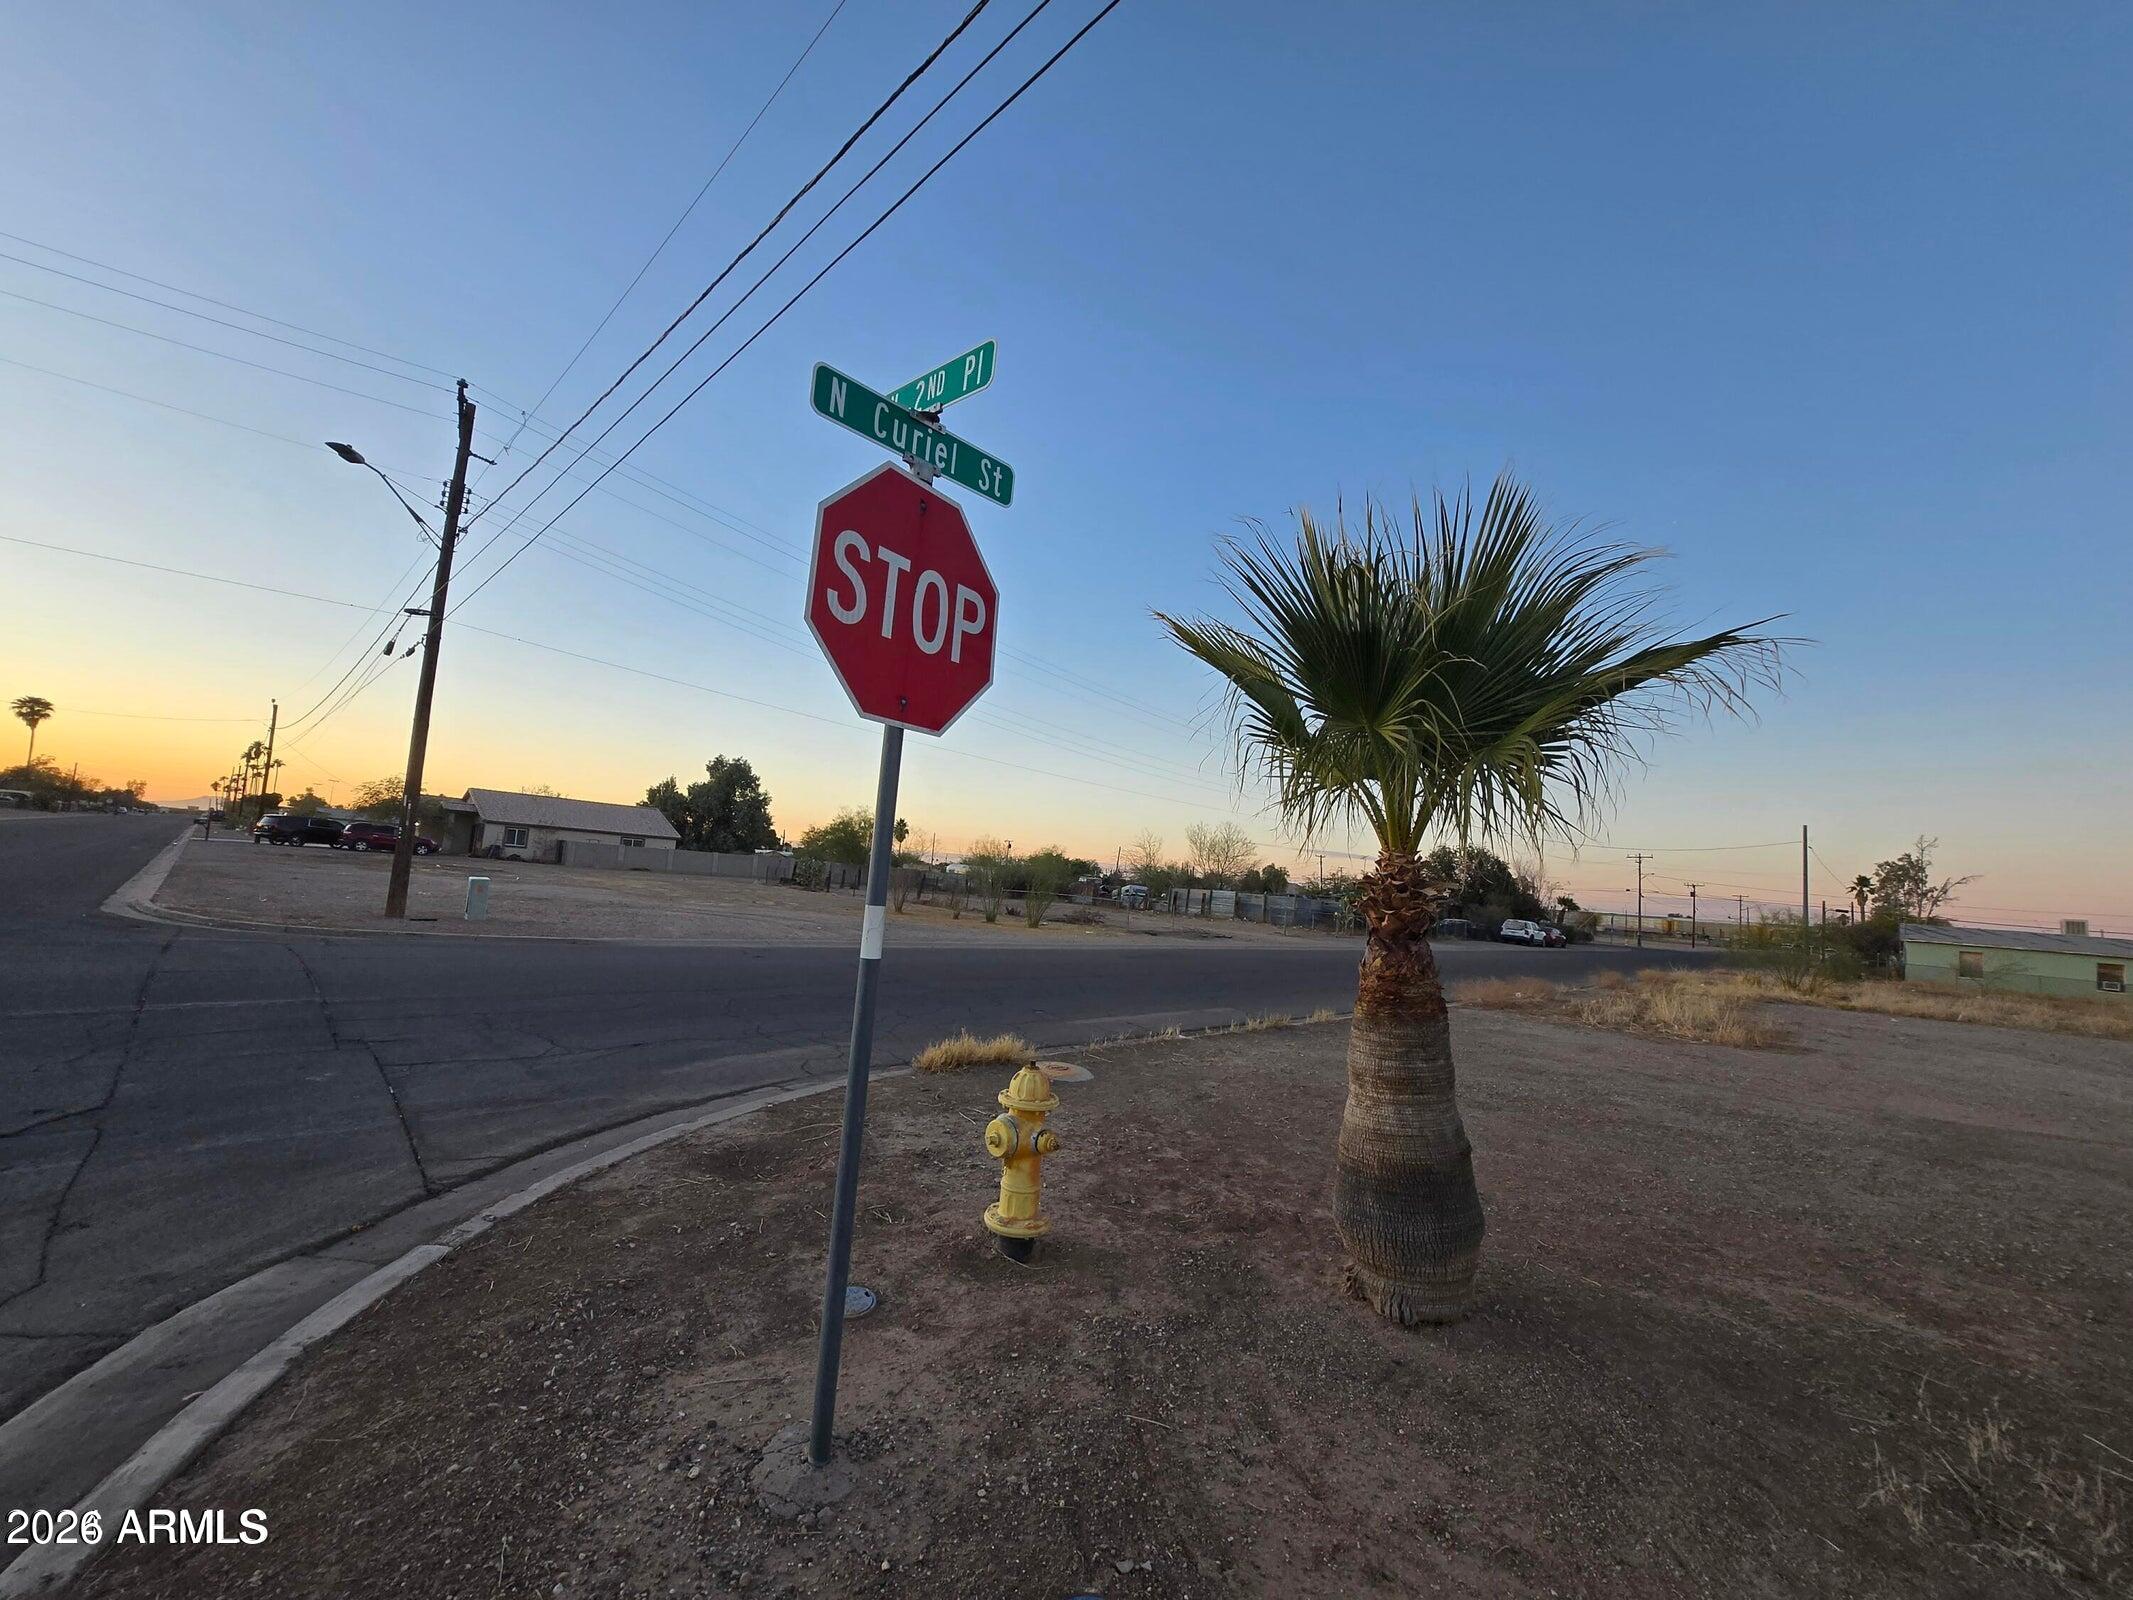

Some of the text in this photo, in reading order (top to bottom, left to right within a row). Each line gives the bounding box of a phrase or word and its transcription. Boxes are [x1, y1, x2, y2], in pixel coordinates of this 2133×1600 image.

[829, 376, 1002, 497] N Curiel St
[915, 370, 945, 411] 2ND
[827, 530, 986, 663] STOP
